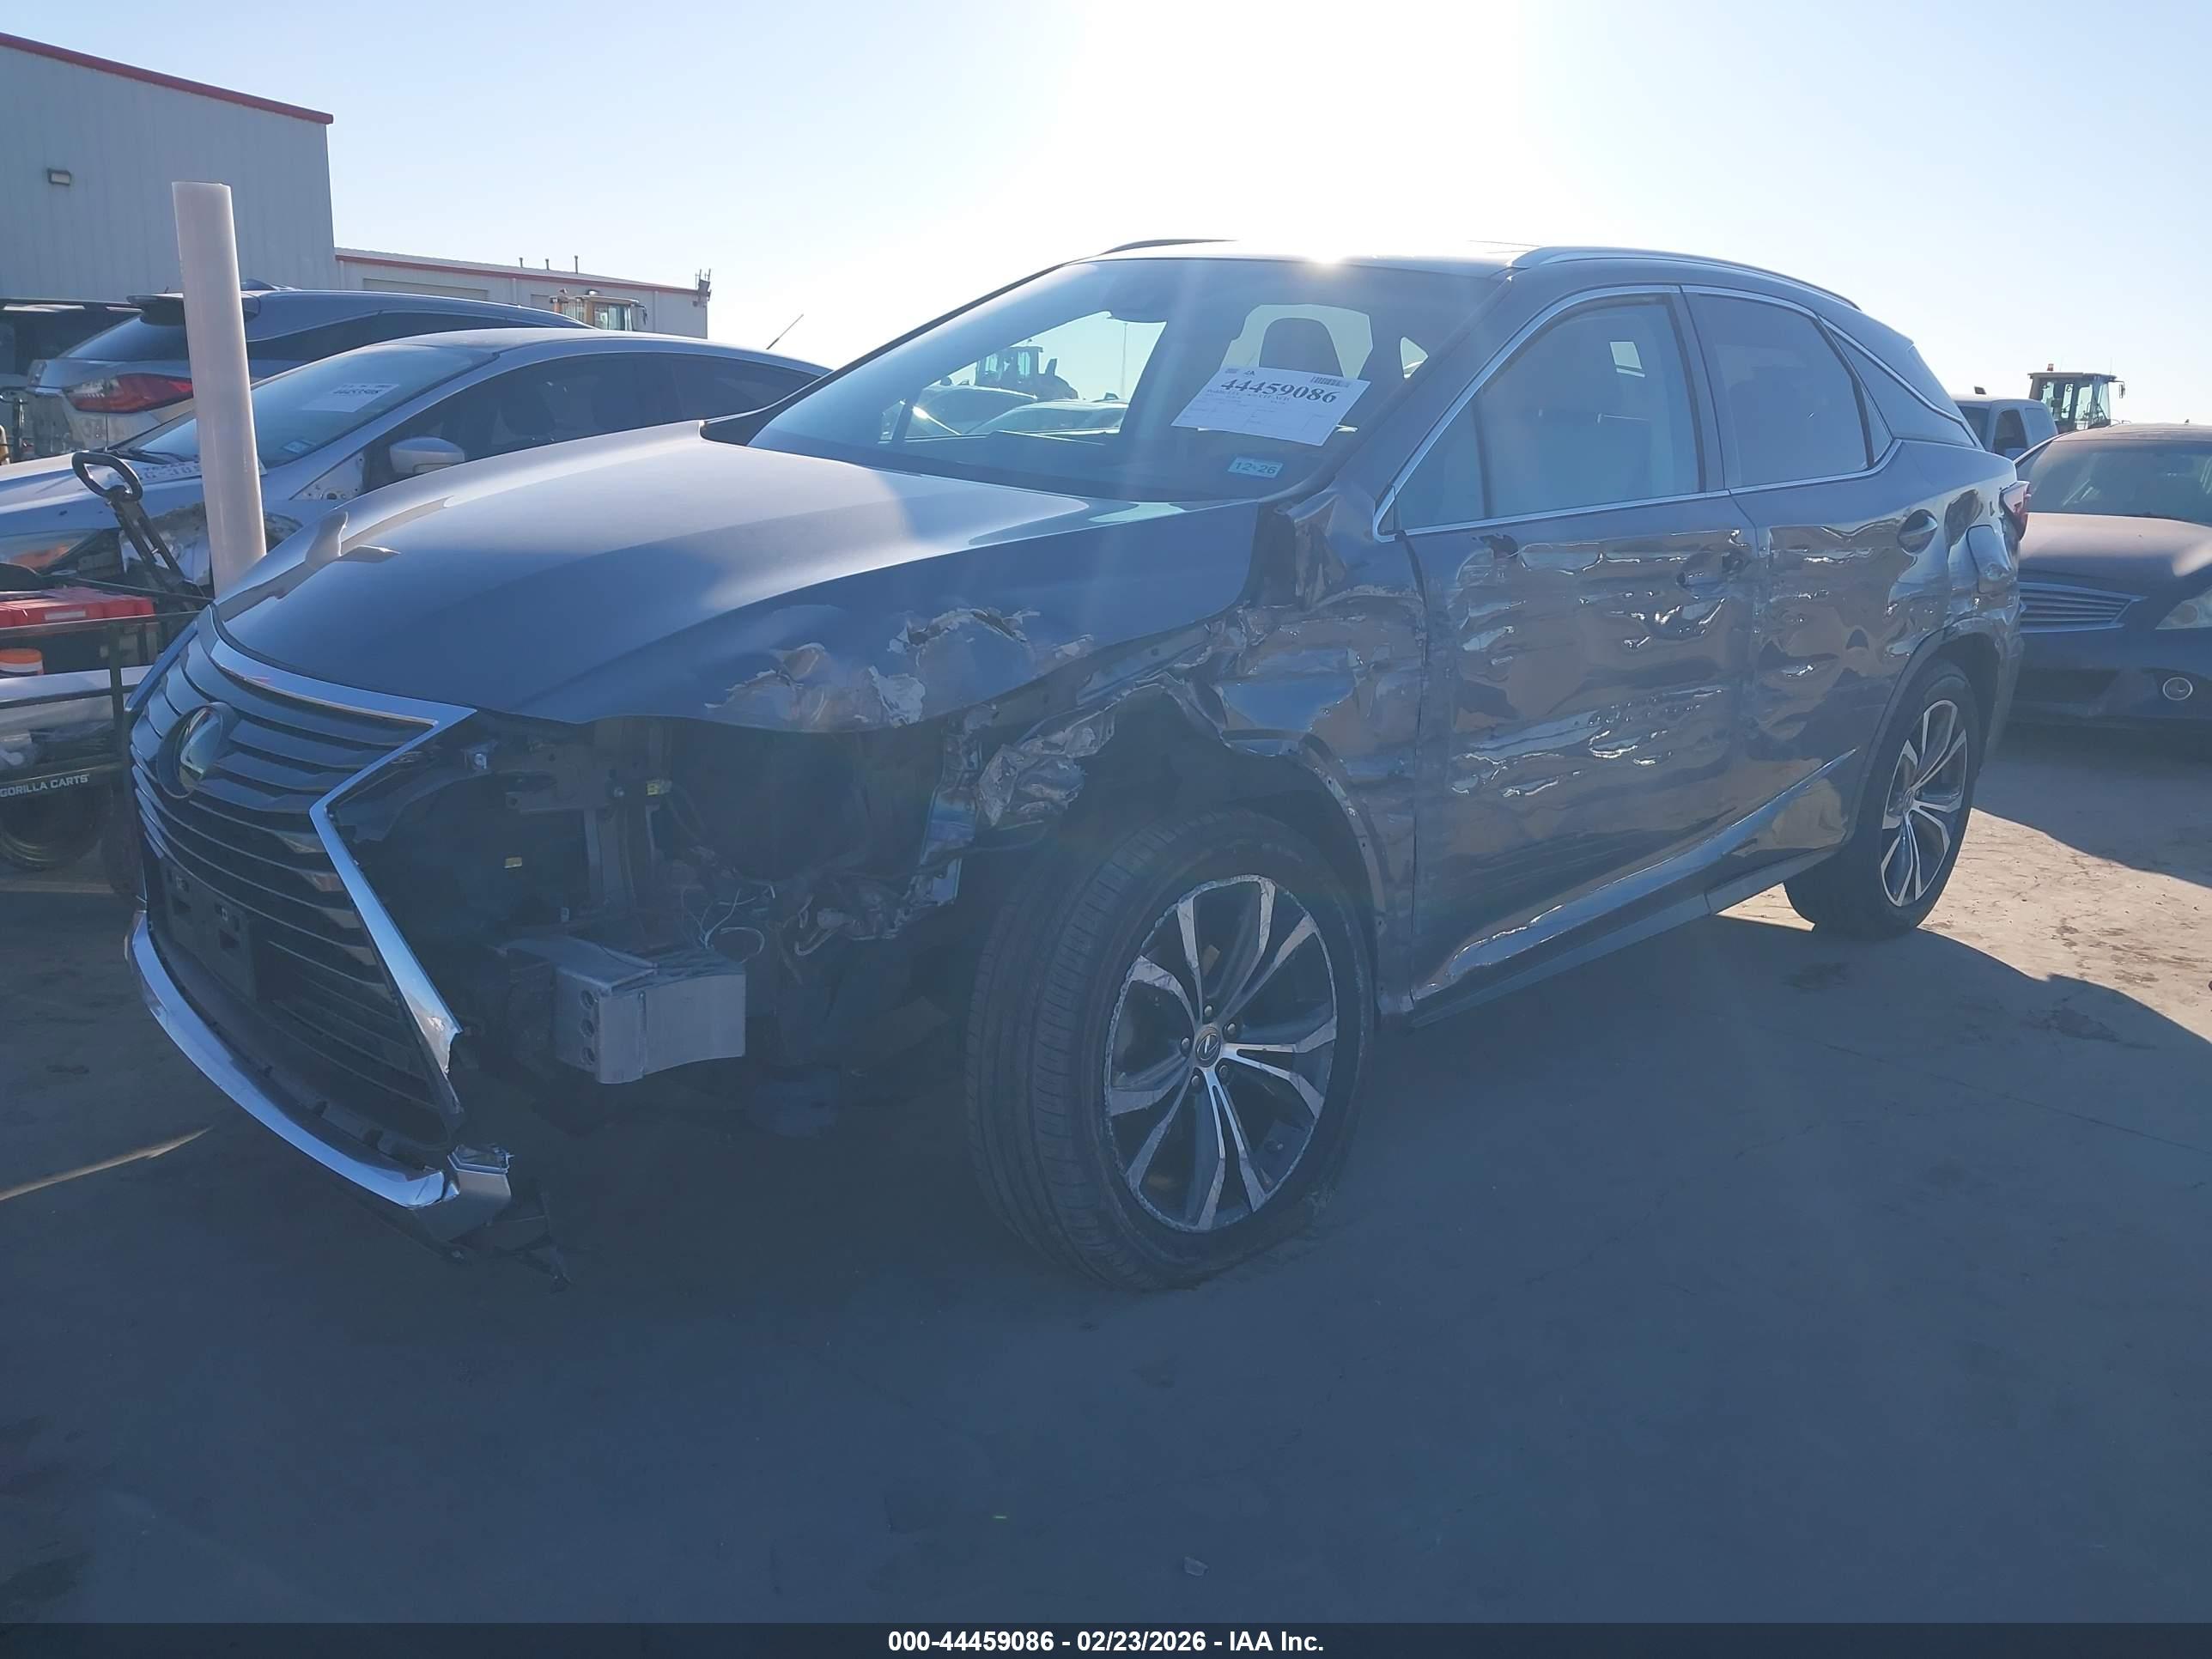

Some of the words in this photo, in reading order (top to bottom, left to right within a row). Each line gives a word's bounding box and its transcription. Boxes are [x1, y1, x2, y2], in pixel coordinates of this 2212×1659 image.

[1220, 379, 1341, 404] 44459086
[0, 781, 48, 797] GORILLA
[50, 775, 89, 789] CARTS
